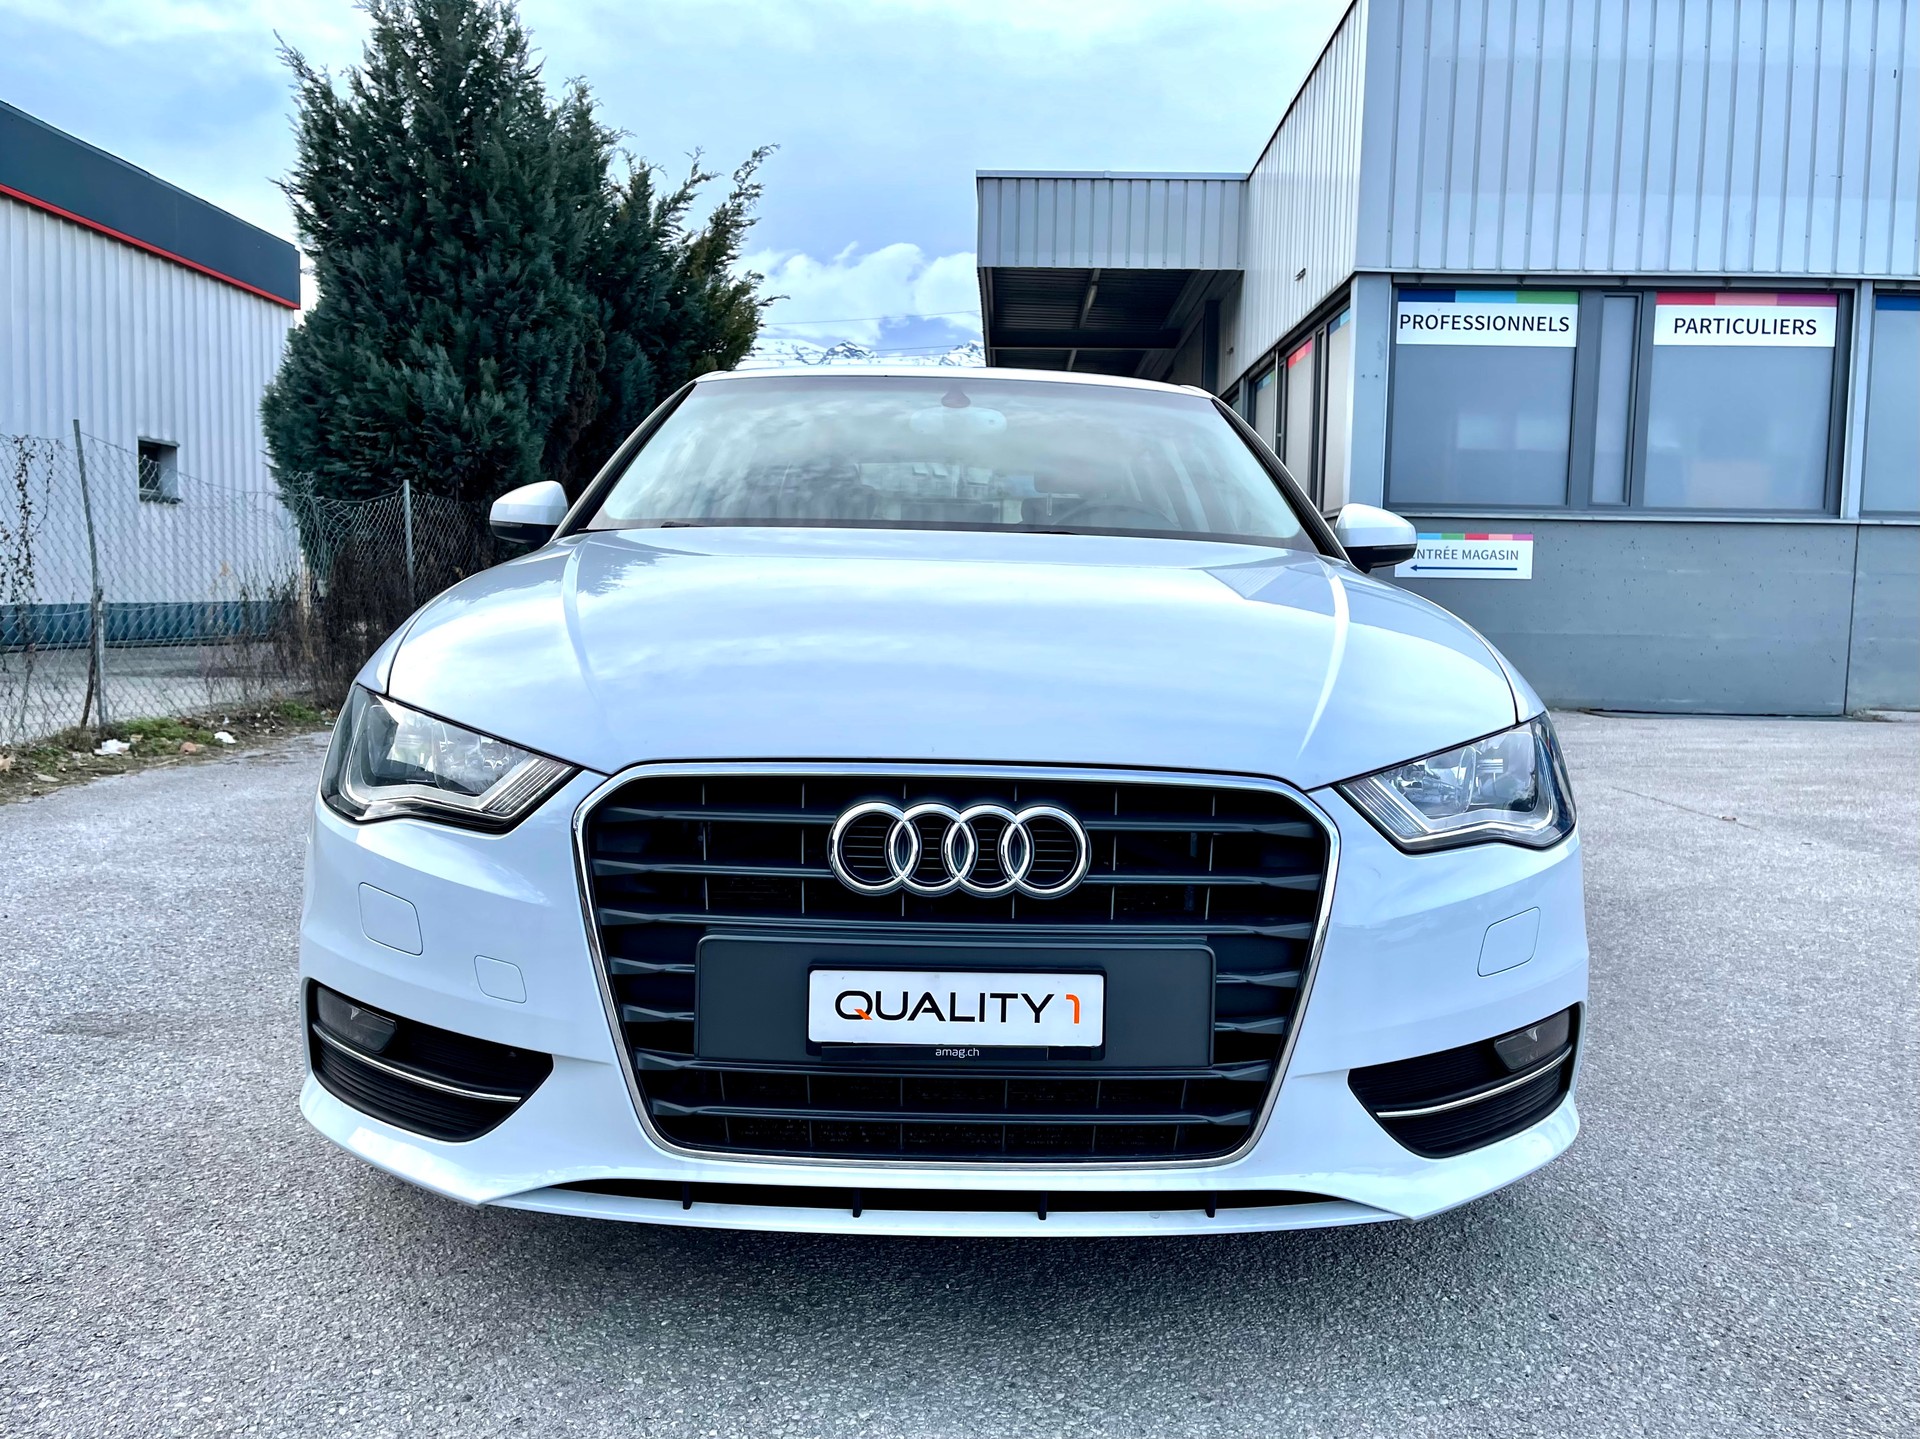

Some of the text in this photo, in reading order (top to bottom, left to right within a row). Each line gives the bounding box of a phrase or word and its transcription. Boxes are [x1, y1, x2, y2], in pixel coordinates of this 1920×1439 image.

[1399, 313, 1570, 333] PROFESSIONNELS
[1673, 317, 1818, 336] PARTICULIERS
[1411, 546, 1519, 560] NTRÉE MAGASIN
[834, 990, 1081, 1024] QUALITY 1
[935, 1047, 980, 1058] amag.ch
